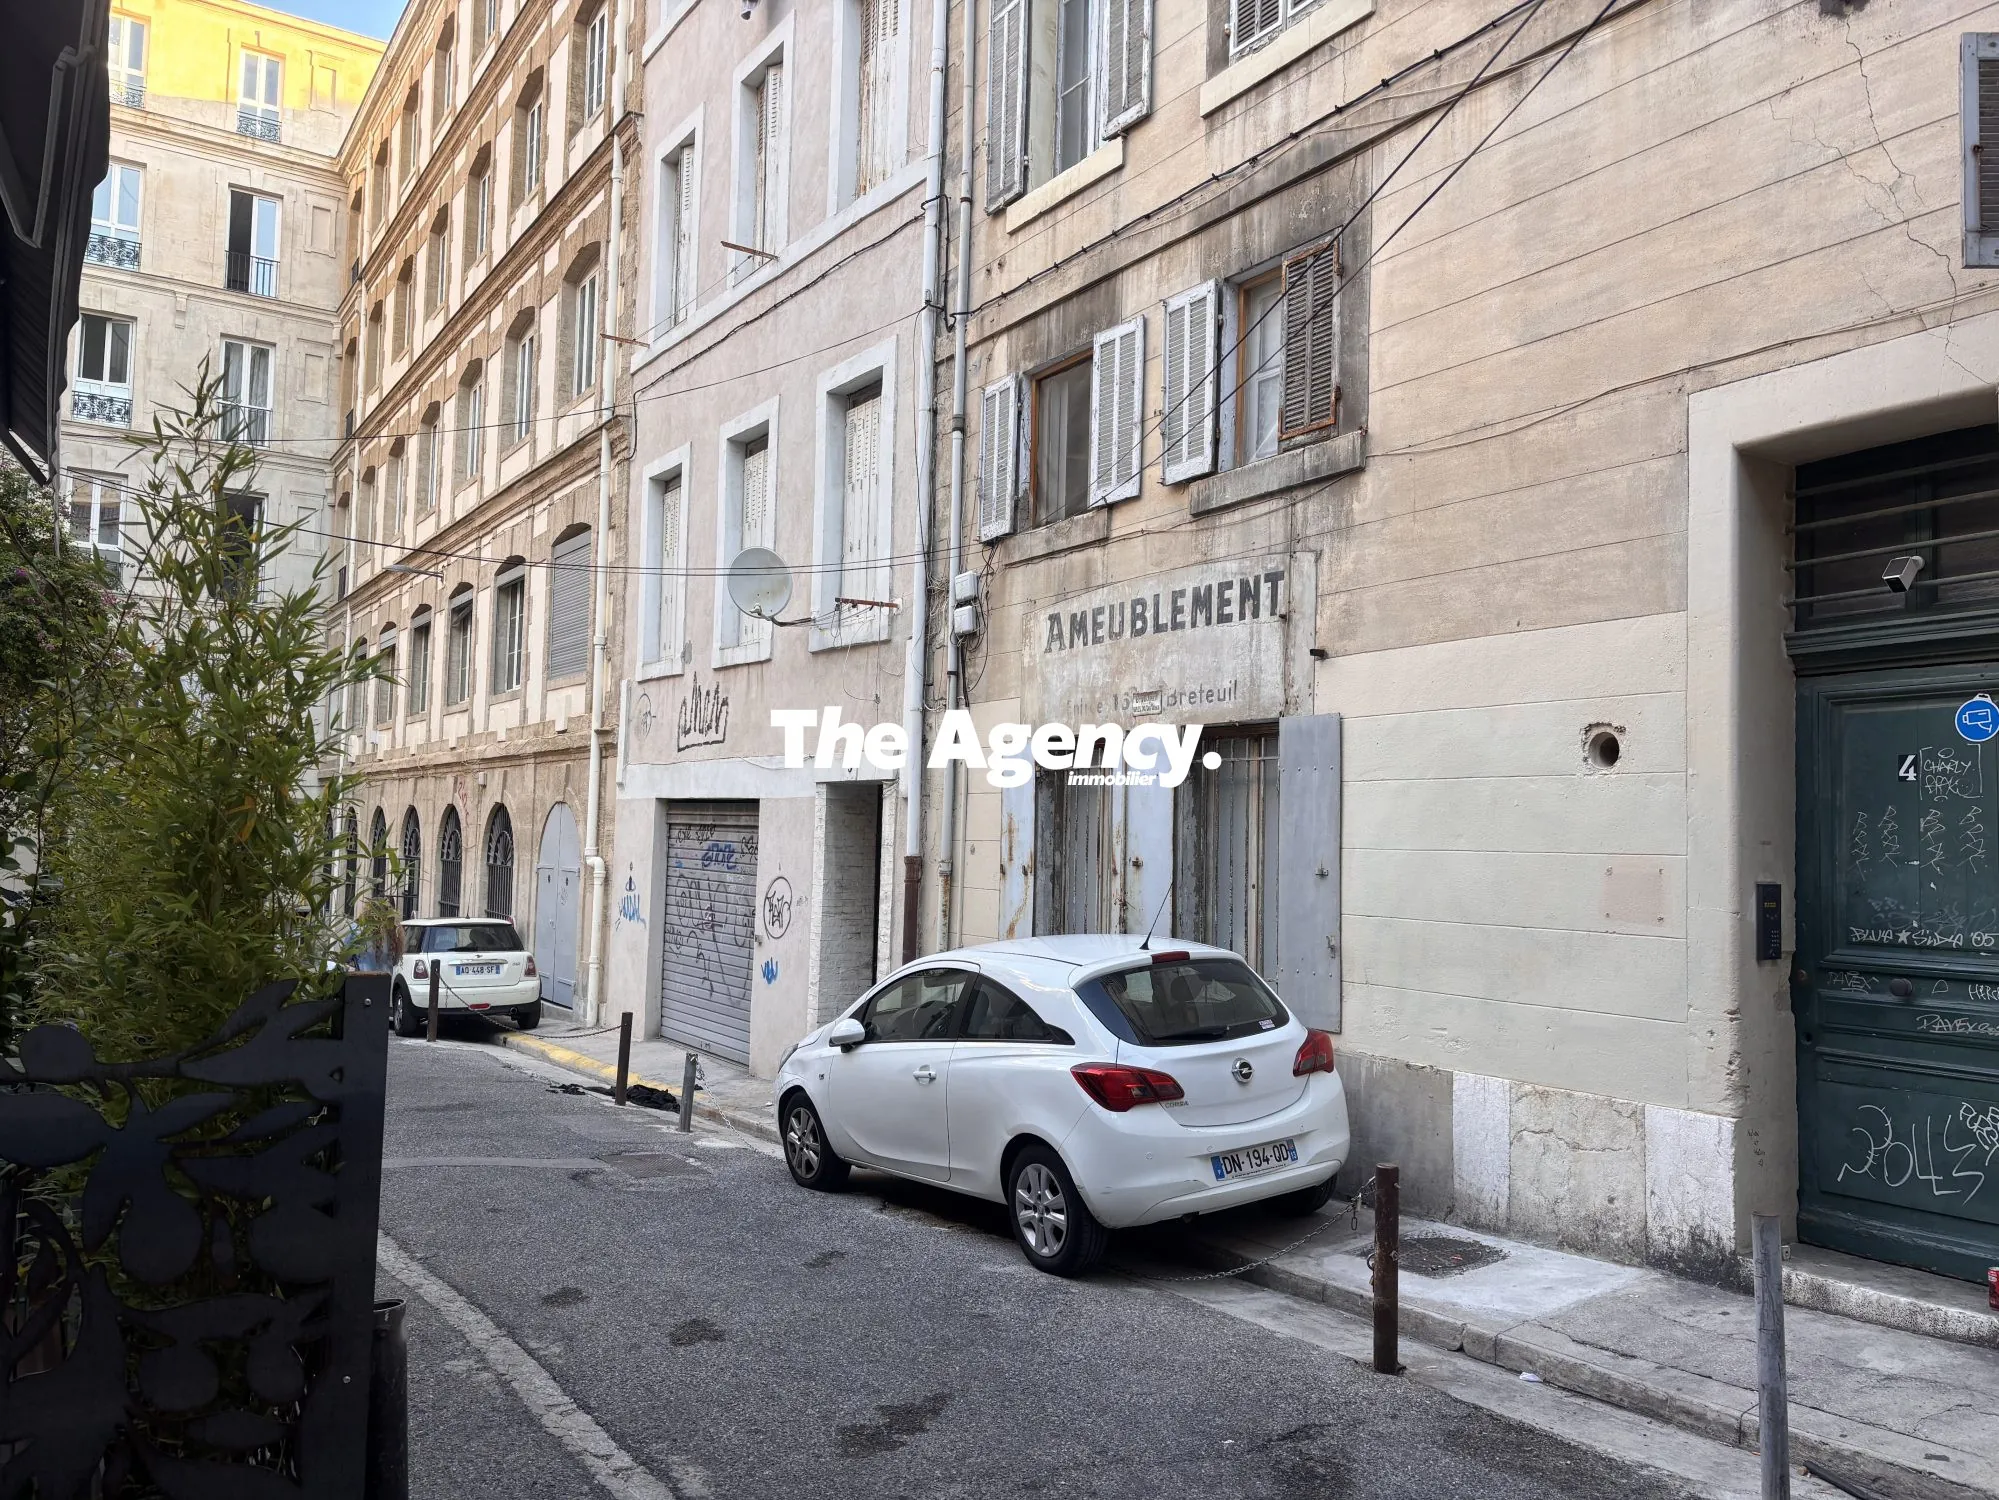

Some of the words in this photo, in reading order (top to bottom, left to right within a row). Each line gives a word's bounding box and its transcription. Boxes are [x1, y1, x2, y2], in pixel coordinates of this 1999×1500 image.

[1044, 571, 1285, 653] AMEUBLEMENT
[1898, 754, 1917, 781] 4
[1164, 1100, 1190, 1110] CORSA
